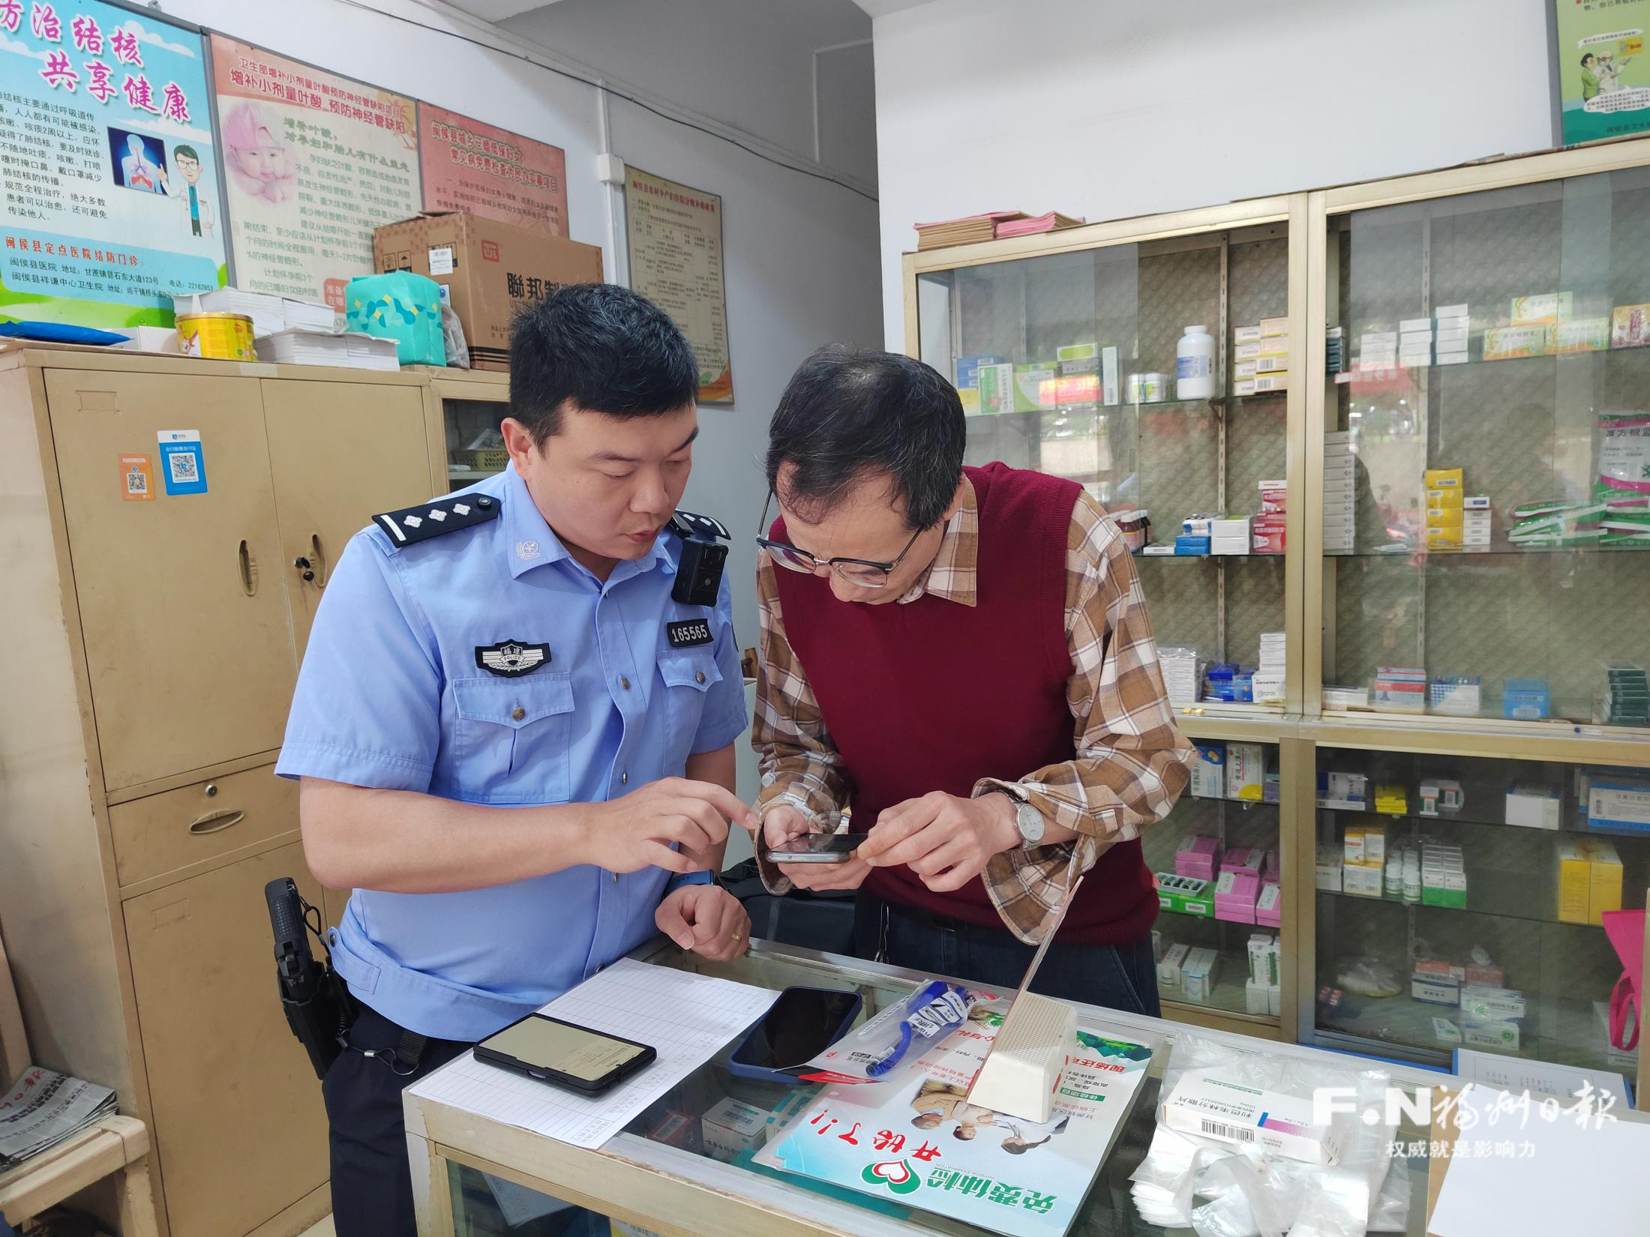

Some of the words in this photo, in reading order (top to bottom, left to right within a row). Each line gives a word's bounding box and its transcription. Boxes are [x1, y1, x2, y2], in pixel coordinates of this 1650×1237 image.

[41, 52, 189, 121] 共享健康
[671, 622, 708, 644] 165565
[925, 1166, 1062, 1216] 免费体检
